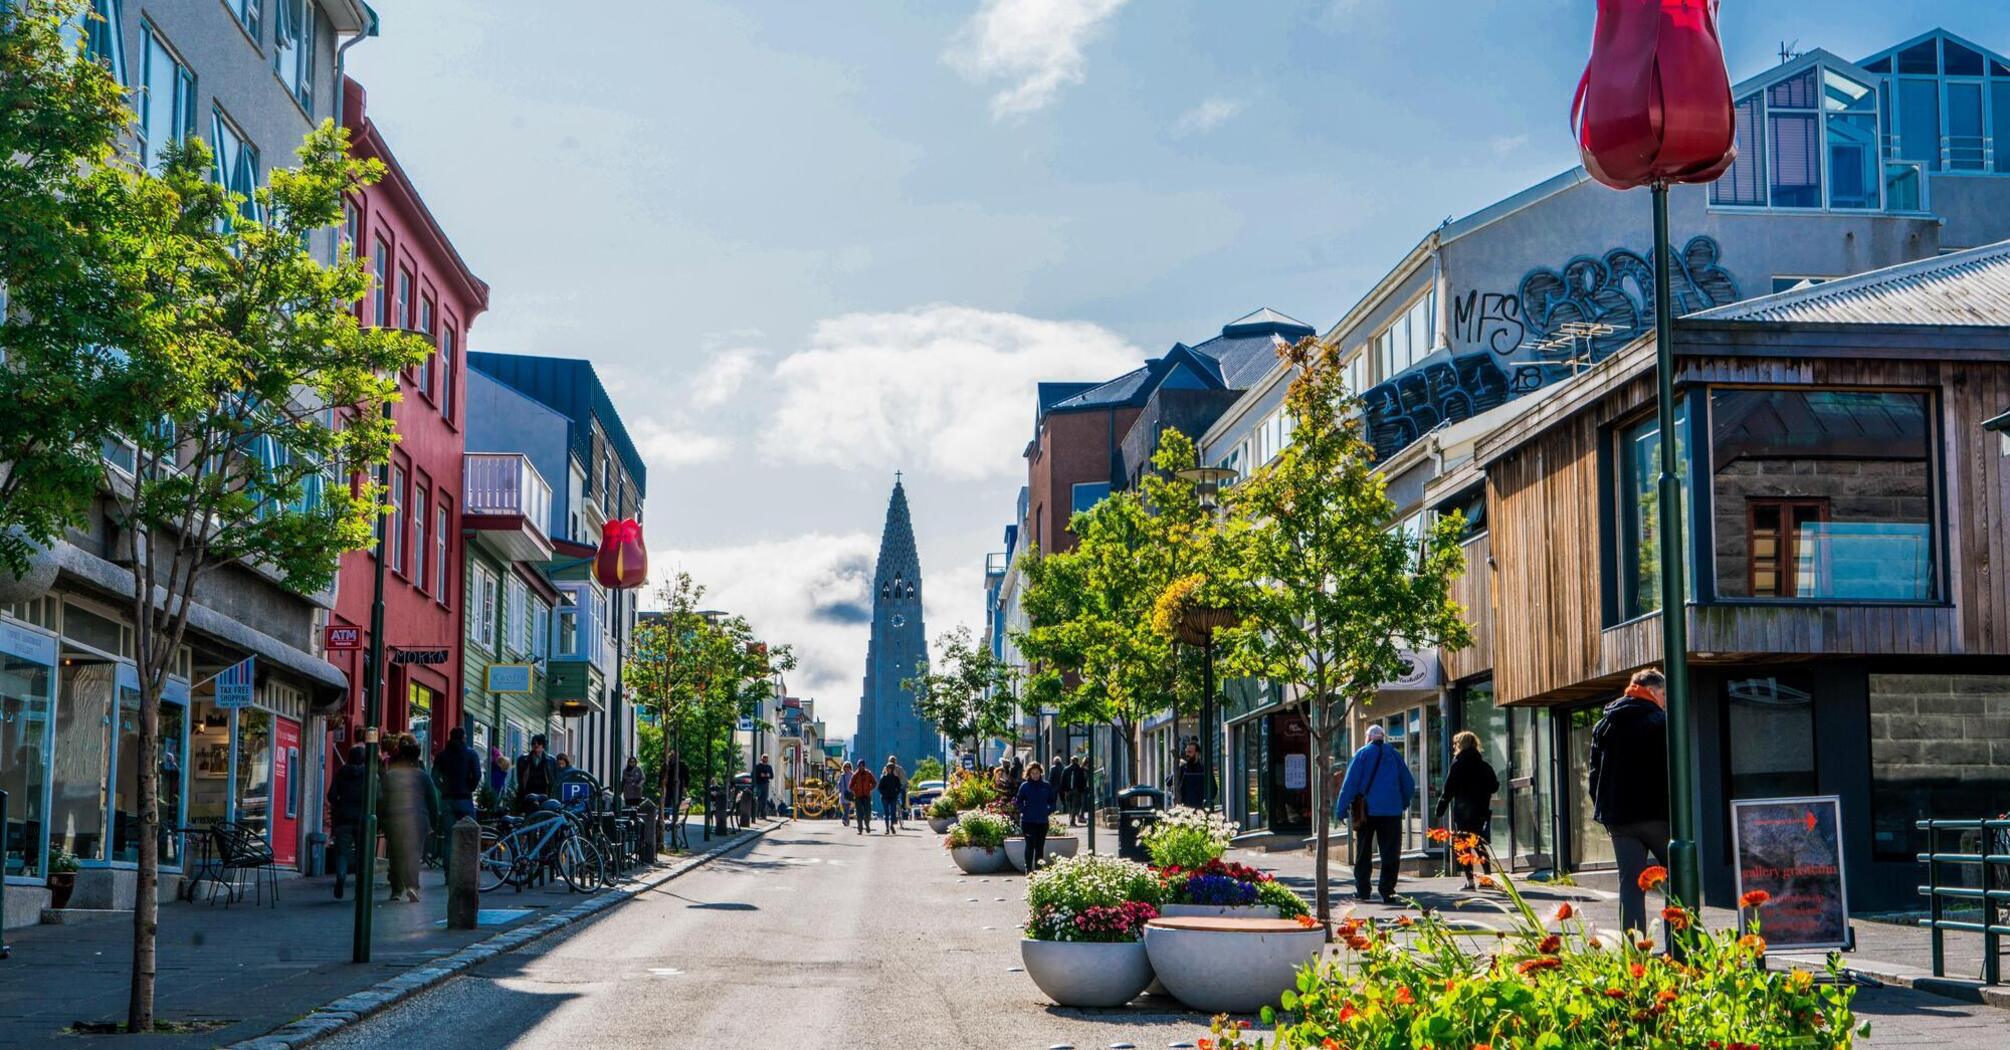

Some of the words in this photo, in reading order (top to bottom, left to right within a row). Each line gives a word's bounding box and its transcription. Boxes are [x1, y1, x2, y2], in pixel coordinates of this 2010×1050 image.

[1455, 289, 1524, 355] MFS
[331, 629, 357, 641] ATM
[396, 650, 447, 664] MOKKA
[220, 686, 231, 694] TAX
[234, 686, 249, 695] FREE
[220, 694, 249, 703] SHOPPING
[571, 785, 580, 797] P
